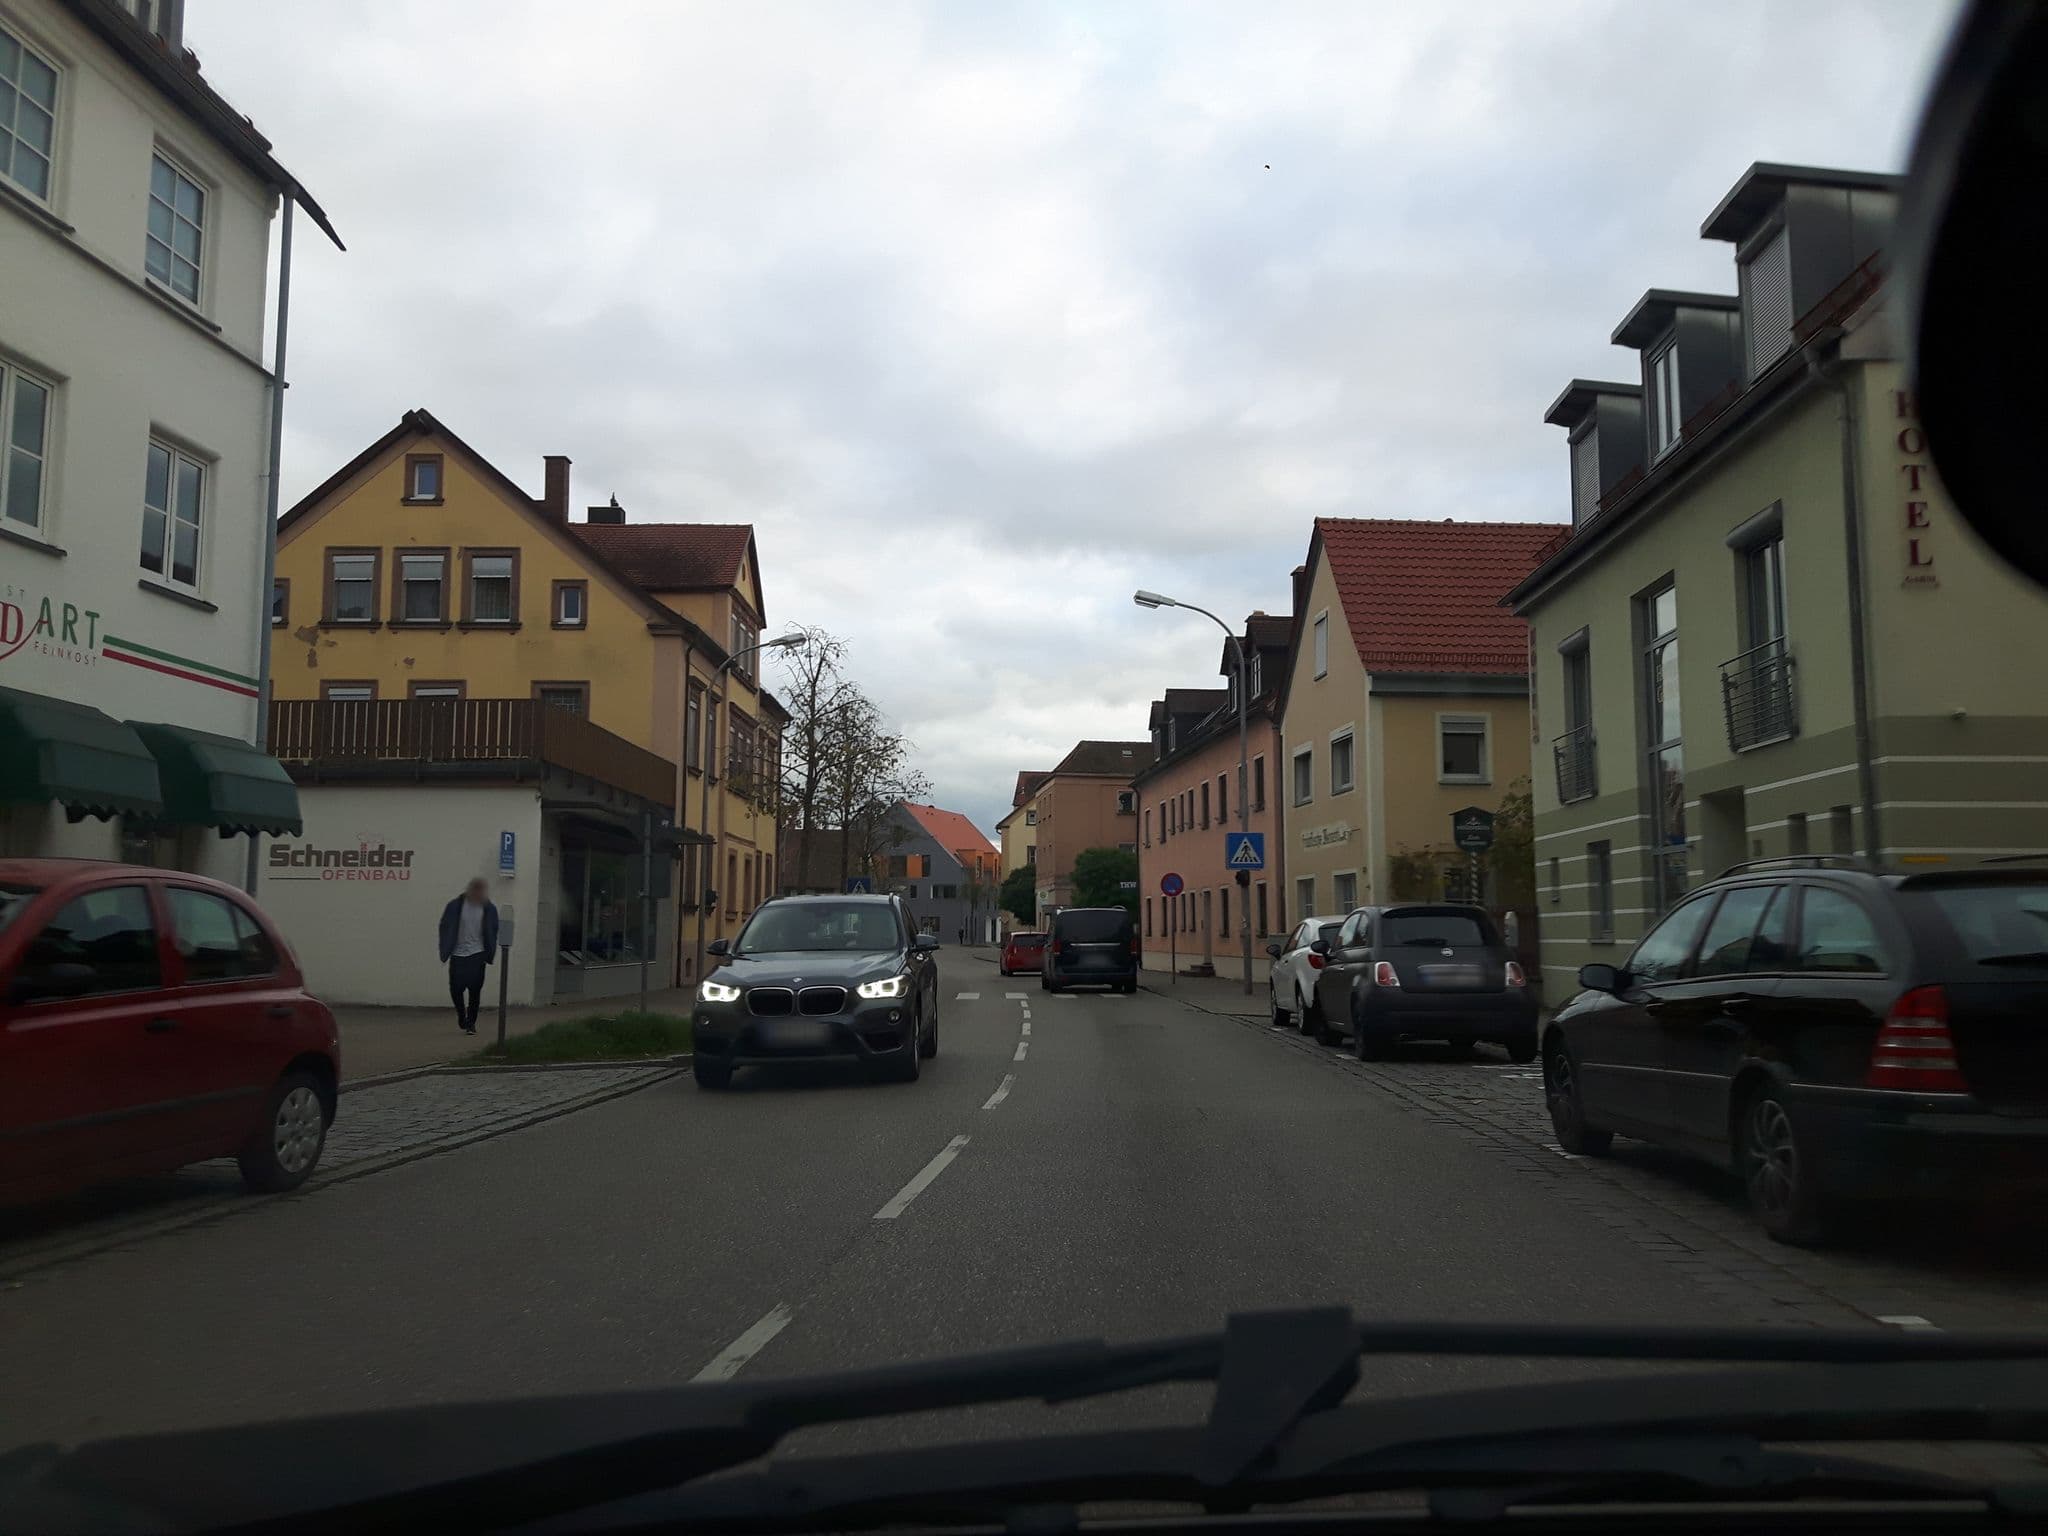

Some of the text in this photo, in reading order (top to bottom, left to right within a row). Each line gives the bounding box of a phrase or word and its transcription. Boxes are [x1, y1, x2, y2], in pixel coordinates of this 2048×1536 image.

[1896, 391, 1934, 567] HOTEL
[504, 833, 512, 850] P
[269, 842, 415, 867] Schneider
[322, 869, 411, 881] OFENBAU
